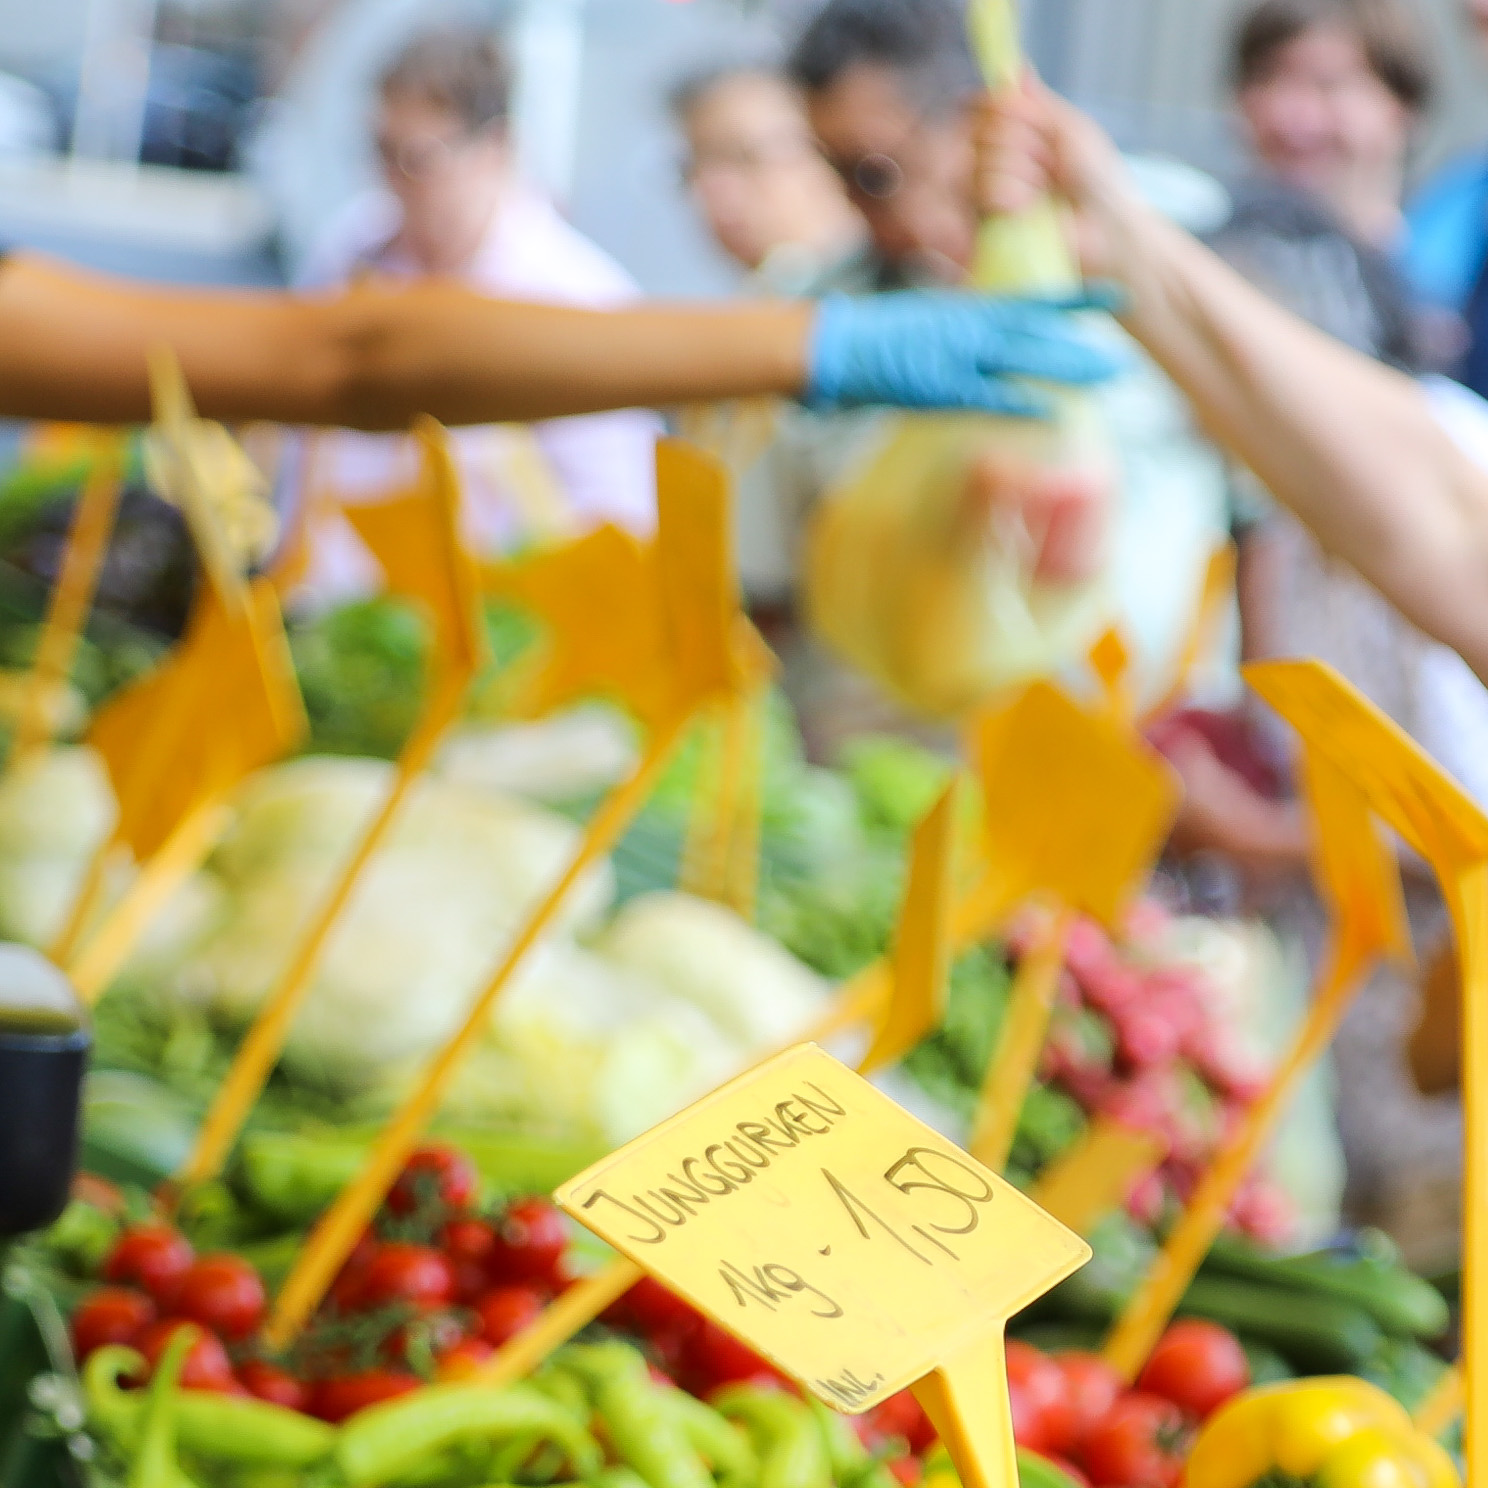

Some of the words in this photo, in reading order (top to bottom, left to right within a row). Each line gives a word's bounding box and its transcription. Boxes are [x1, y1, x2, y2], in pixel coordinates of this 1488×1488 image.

[582, 1080, 847, 1245] JUNGGURKEN
[718, 1258, 844, 1319] 1kg
[820, 1147, 994, 1267] 1,50
